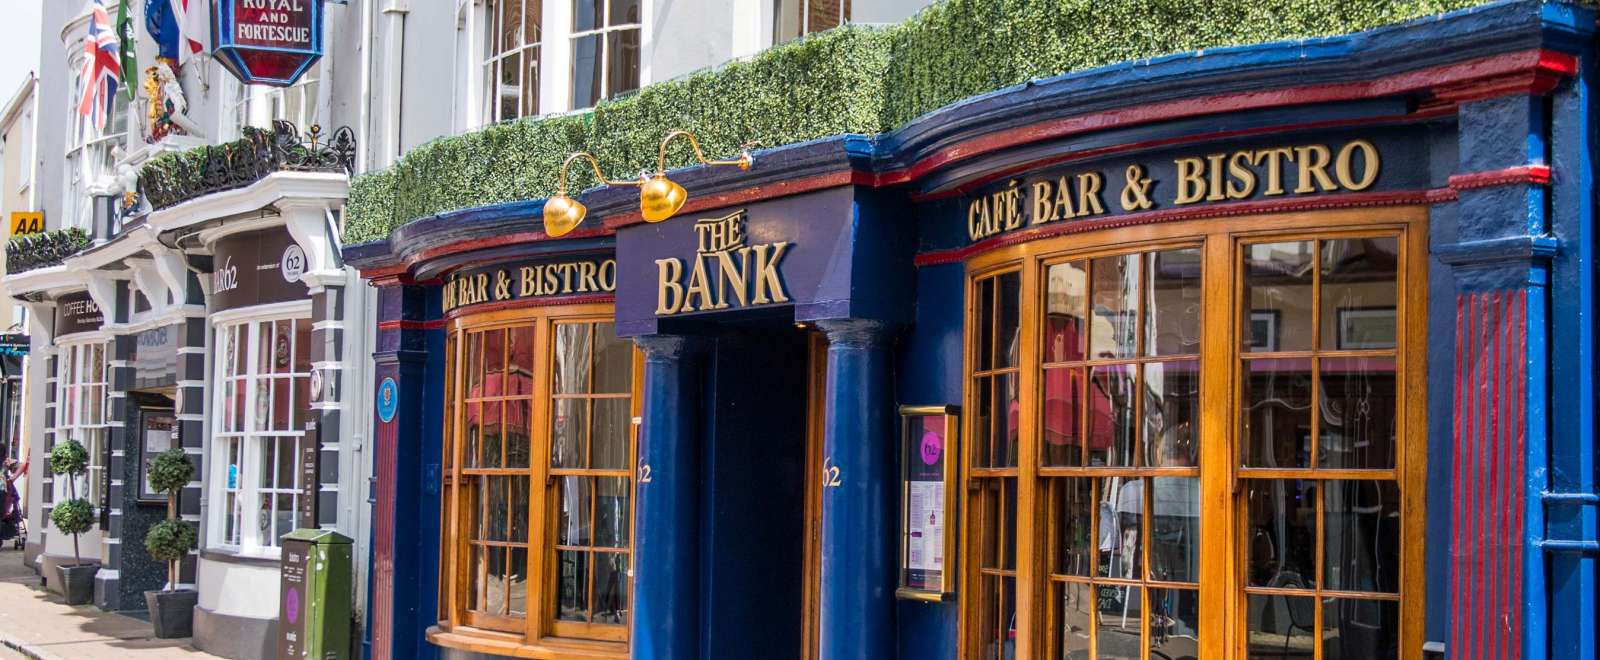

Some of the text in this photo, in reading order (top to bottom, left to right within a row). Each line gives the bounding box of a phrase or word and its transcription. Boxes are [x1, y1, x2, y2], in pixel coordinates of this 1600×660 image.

[259, 12, 289, 23] AND
[238, 23, 309, 42] FORTESCUE
[967, 139, 1381, 241] CAFÉ BAR & BISTRO
[14, 217, 38, 235] AA
[694, 213, 743, 252] THE
[286, 251, 300, 270] 62
[458, 273, 489, 306] BAR
[495, 269, 511, 300] &
[519, 259, 616, 297] BISTRO
[655, 242, 789, 315] BANK
[64, 299, 99, 317] COFFEE HO
[823, 457, 841, 487] 62
